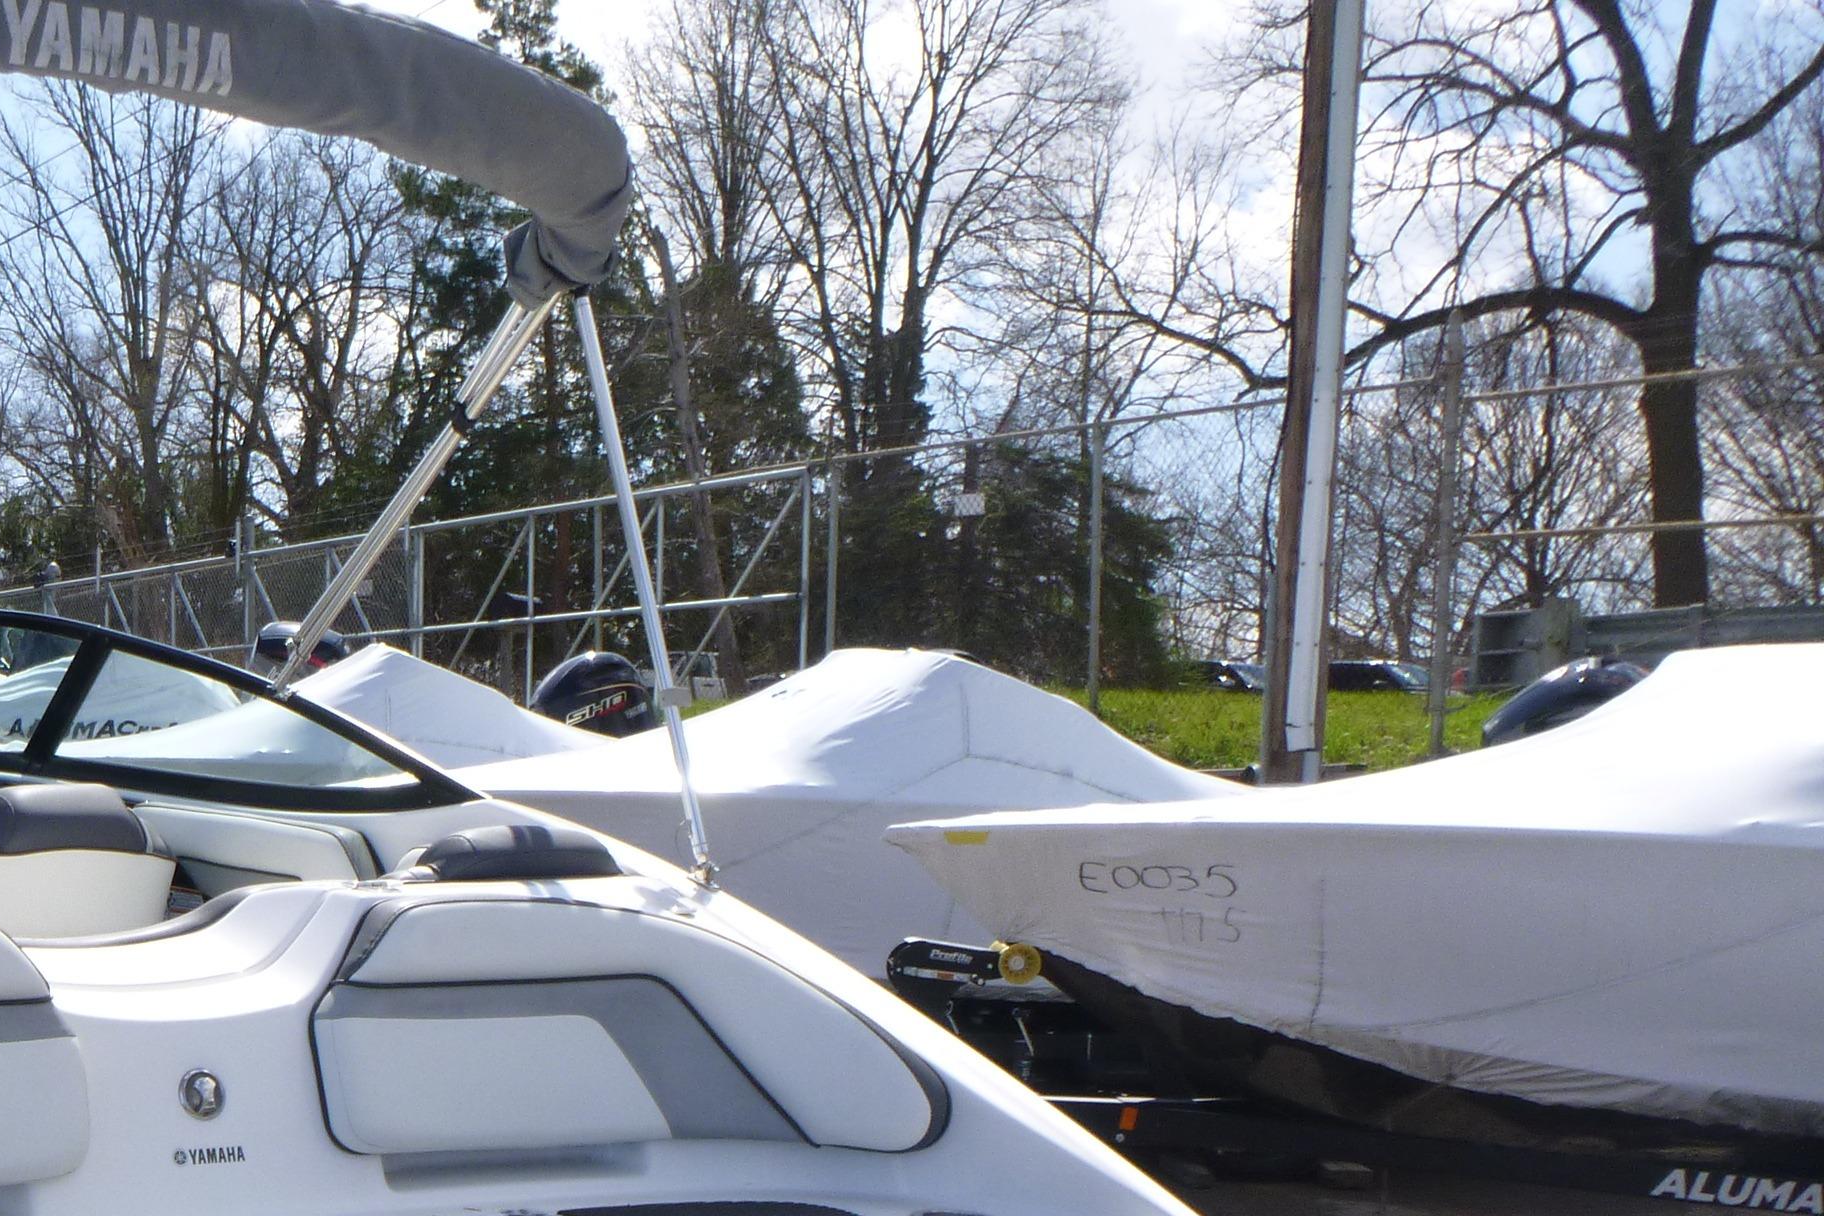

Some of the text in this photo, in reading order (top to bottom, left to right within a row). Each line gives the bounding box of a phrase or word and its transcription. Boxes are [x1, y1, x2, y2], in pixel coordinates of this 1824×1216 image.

[2, 0, 233, 96] YAMAHA
[1079, 862, 1237, 898] E0035
[188, 1146, 246, 1165] YAMAHA
[1649, 1168, 1824, 1215] ALUMA
